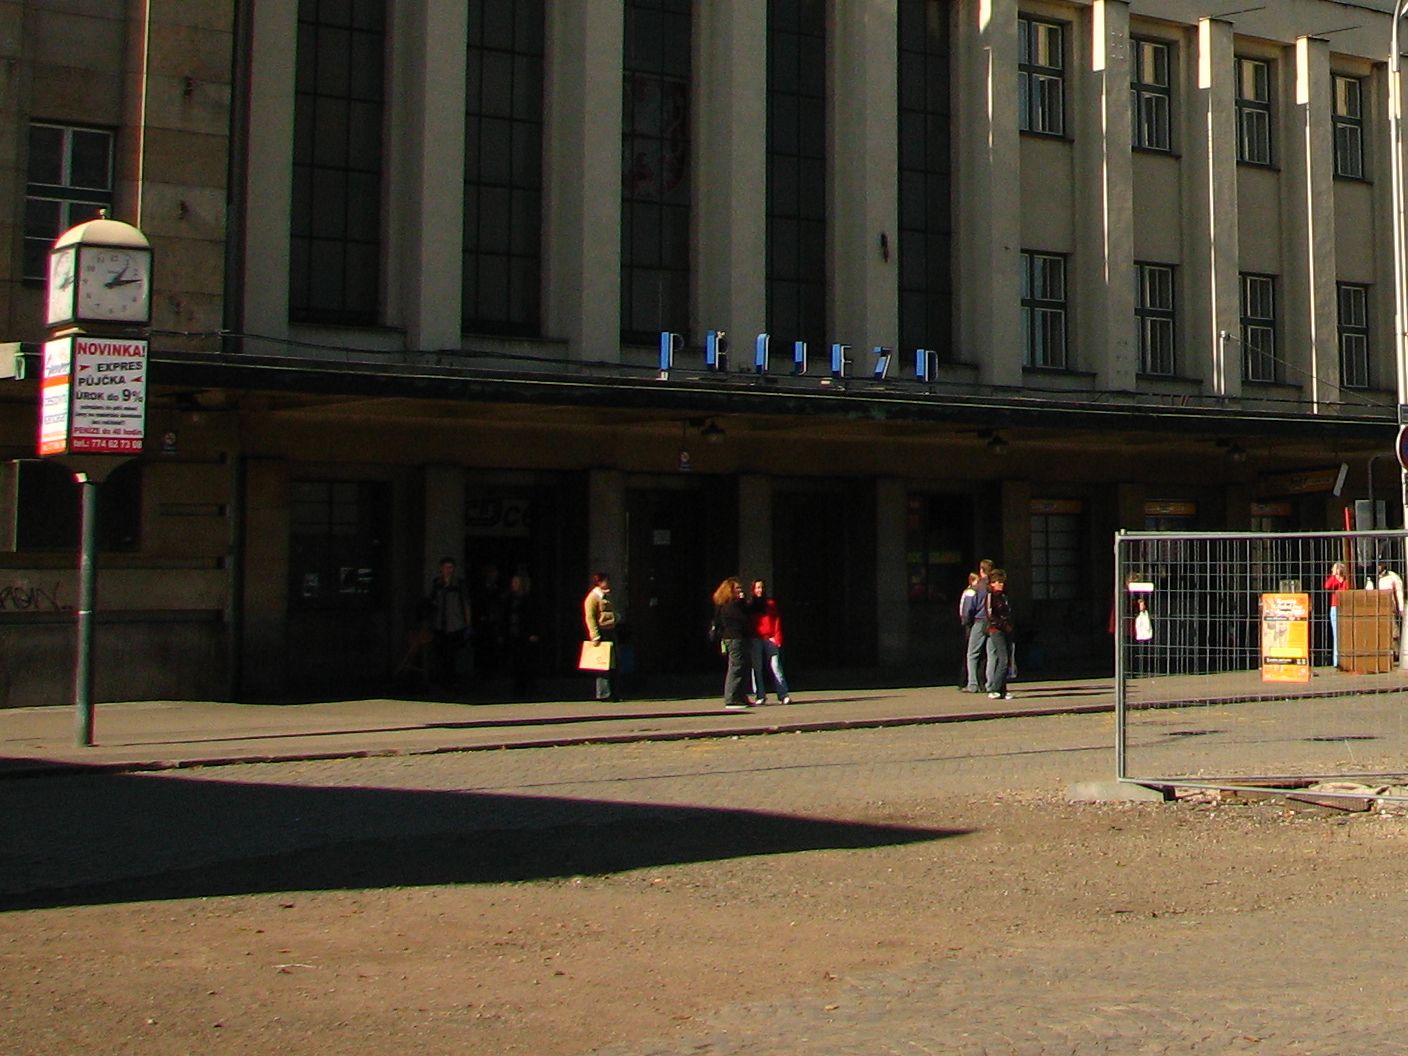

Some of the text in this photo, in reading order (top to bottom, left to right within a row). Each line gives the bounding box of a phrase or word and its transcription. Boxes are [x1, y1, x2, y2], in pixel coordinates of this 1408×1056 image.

[76, 342, 146, 358] NOVINKA!
[96, 361, 143, 373] EXPRES
[75, 390, 105, 401] ÚROK
[106, 393, 119, 401] do
[121, 388, 144, 403] 9%
